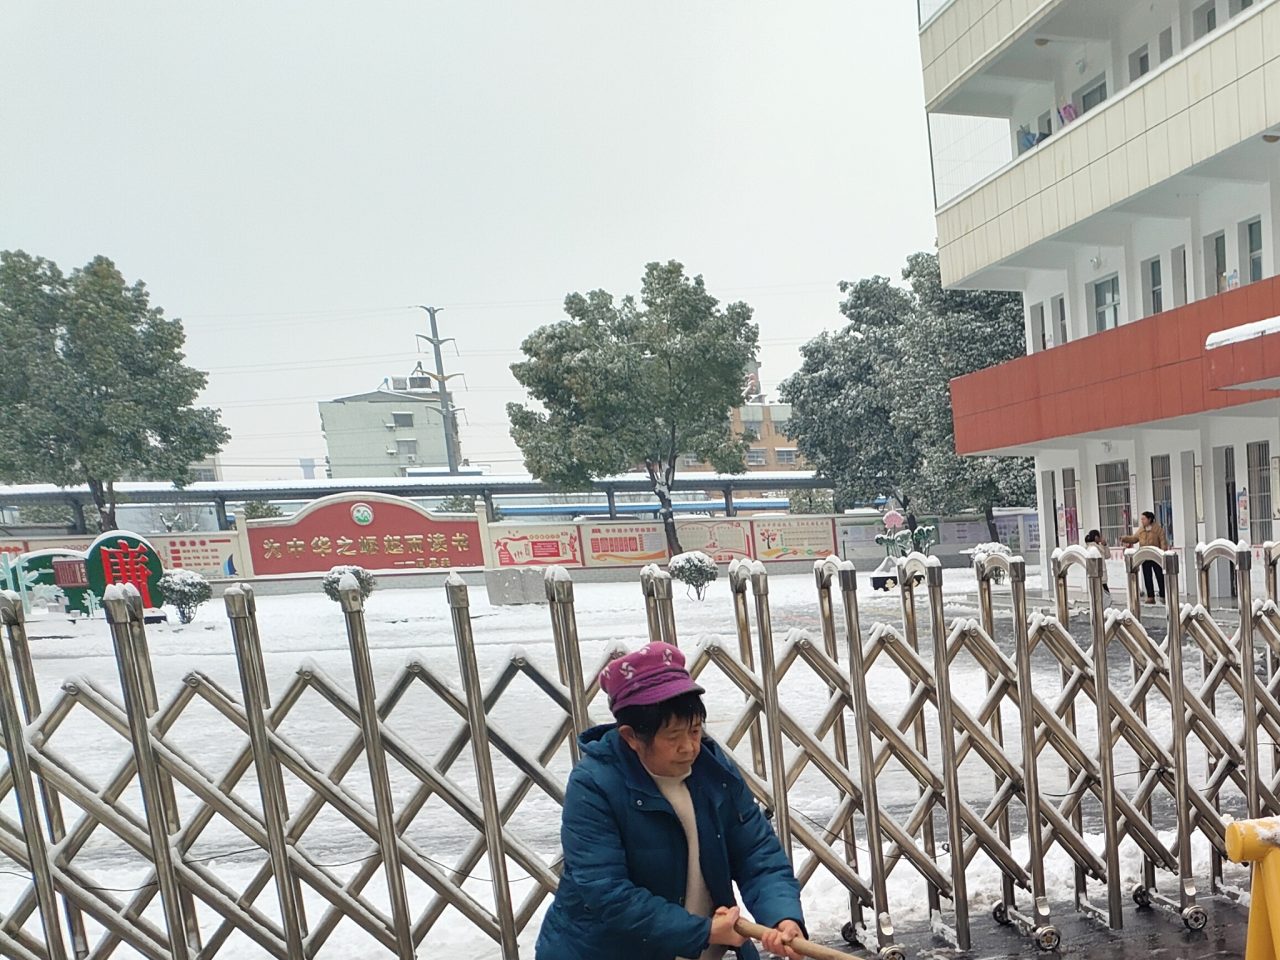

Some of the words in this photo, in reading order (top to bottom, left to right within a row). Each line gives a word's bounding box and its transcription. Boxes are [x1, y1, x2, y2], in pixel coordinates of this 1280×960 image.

[262, 532, 470, 560] 为中华之崛起而读书
[100, 539, 152, 609] 廉
